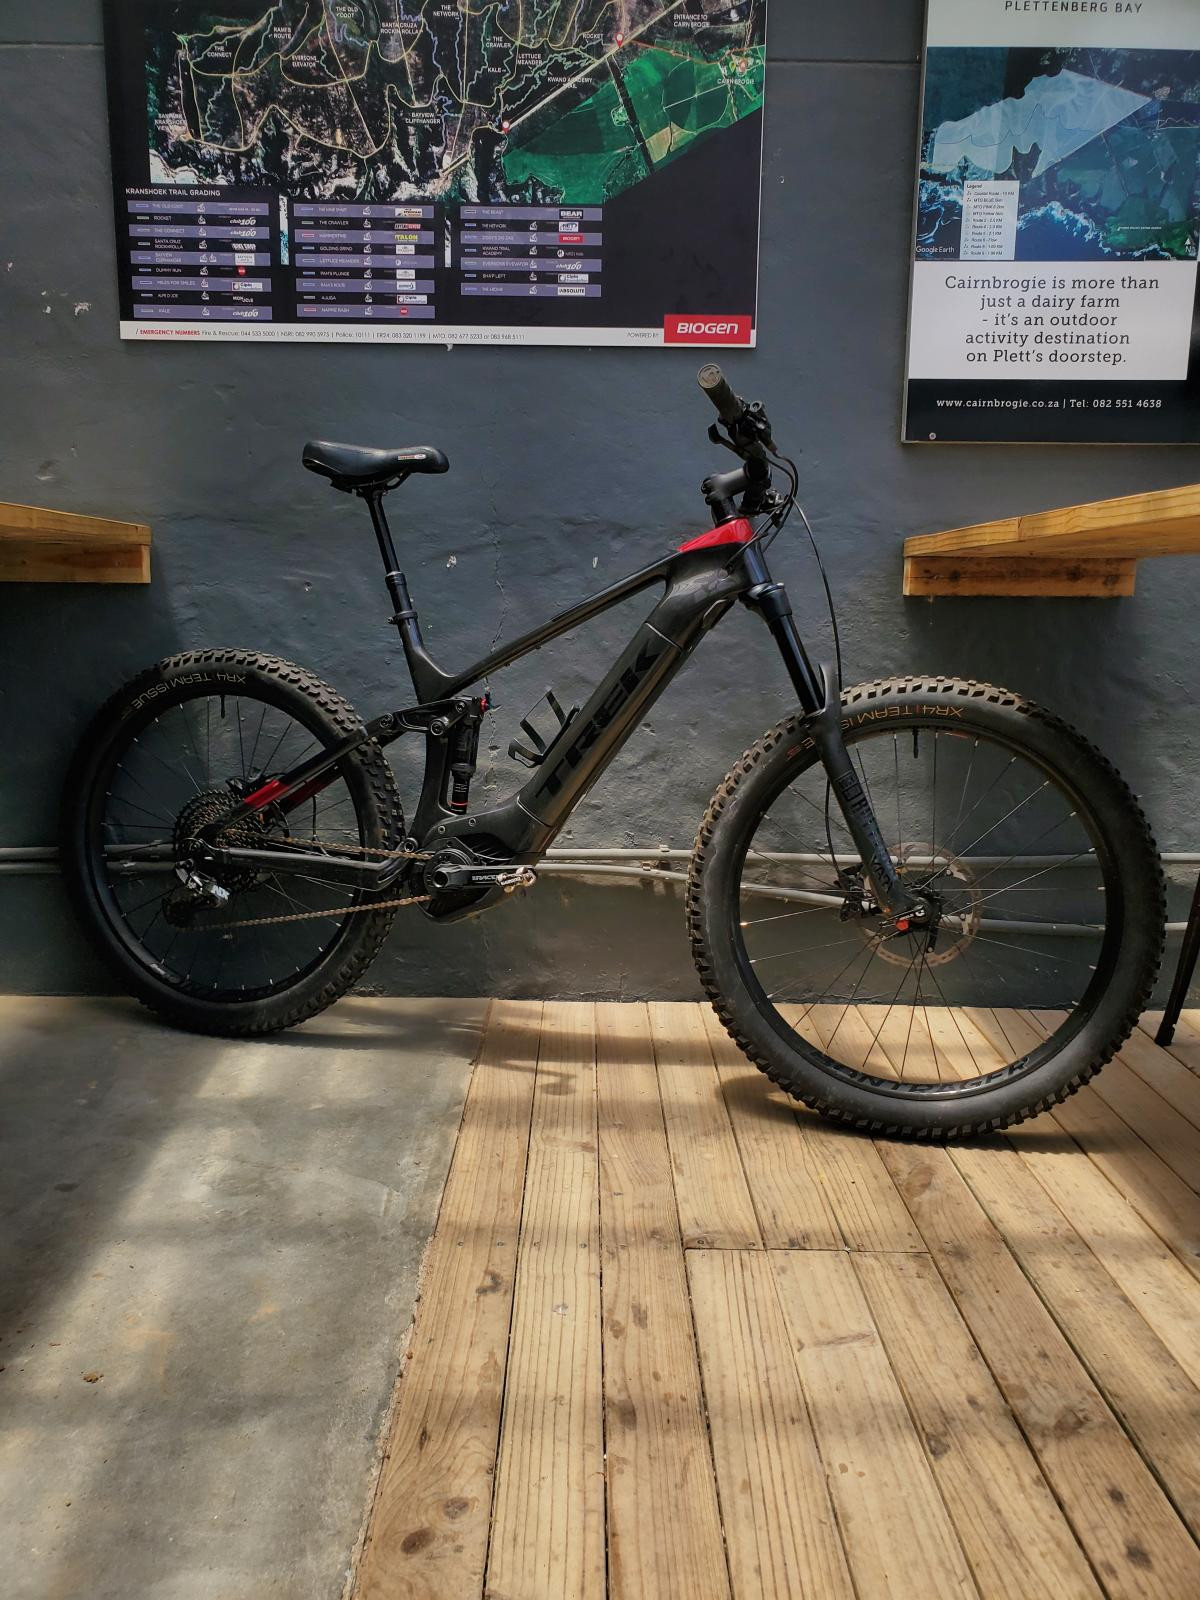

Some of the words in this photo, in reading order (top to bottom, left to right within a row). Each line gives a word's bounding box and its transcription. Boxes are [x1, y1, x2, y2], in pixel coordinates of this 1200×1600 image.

[1005, 1, 1108, 12] PLETTENBERG
[1115, 3, 1143, 13] BAY
[916, 246, 938, 254] Google
[945, 276, 1046, 292] Cairnbrogie
[1052, 276, 1065, 289] is
[1072, 279, 1115, 289] more
[1120, 276, 1160, 289] than
[980, 295, 1012, 310] just
[1017, 298, 1026, 308] a
[1032, 295, 1075, 310] dairy
[1080, 295, 1120, 308] farm
[994, 313, 1018, 326] it's
[1024, 316, 1044, 326] an
[1050, 313, 1118, 326] outdoor
[966, 332, 1028, 347] activity
[1034, 332, 1130, 345] destination
[966, 353, 987, 362] on
[993, 350, 1043, 362] Plett's
[1049, 350, 1126, 365] doorstep.
[936, 398, 1059, 409] www.cairnbrogie.co.za
[1070, 399, 1089, 408] Tel:
[1093, 399, 1112, 408] 082
[1115, 400, 1133, 408] 551
[1136, 400, 1162, 408] 4638
[171, 672, 212, 688] TEAM
[216, 672, 248, 685] XR4
[131, 683, 170, 709] ISSUE
[536, 640, 660, 798] TREK
[858, 706, 912, 725] TEAM
[923, 704, 964, 720] XR4
